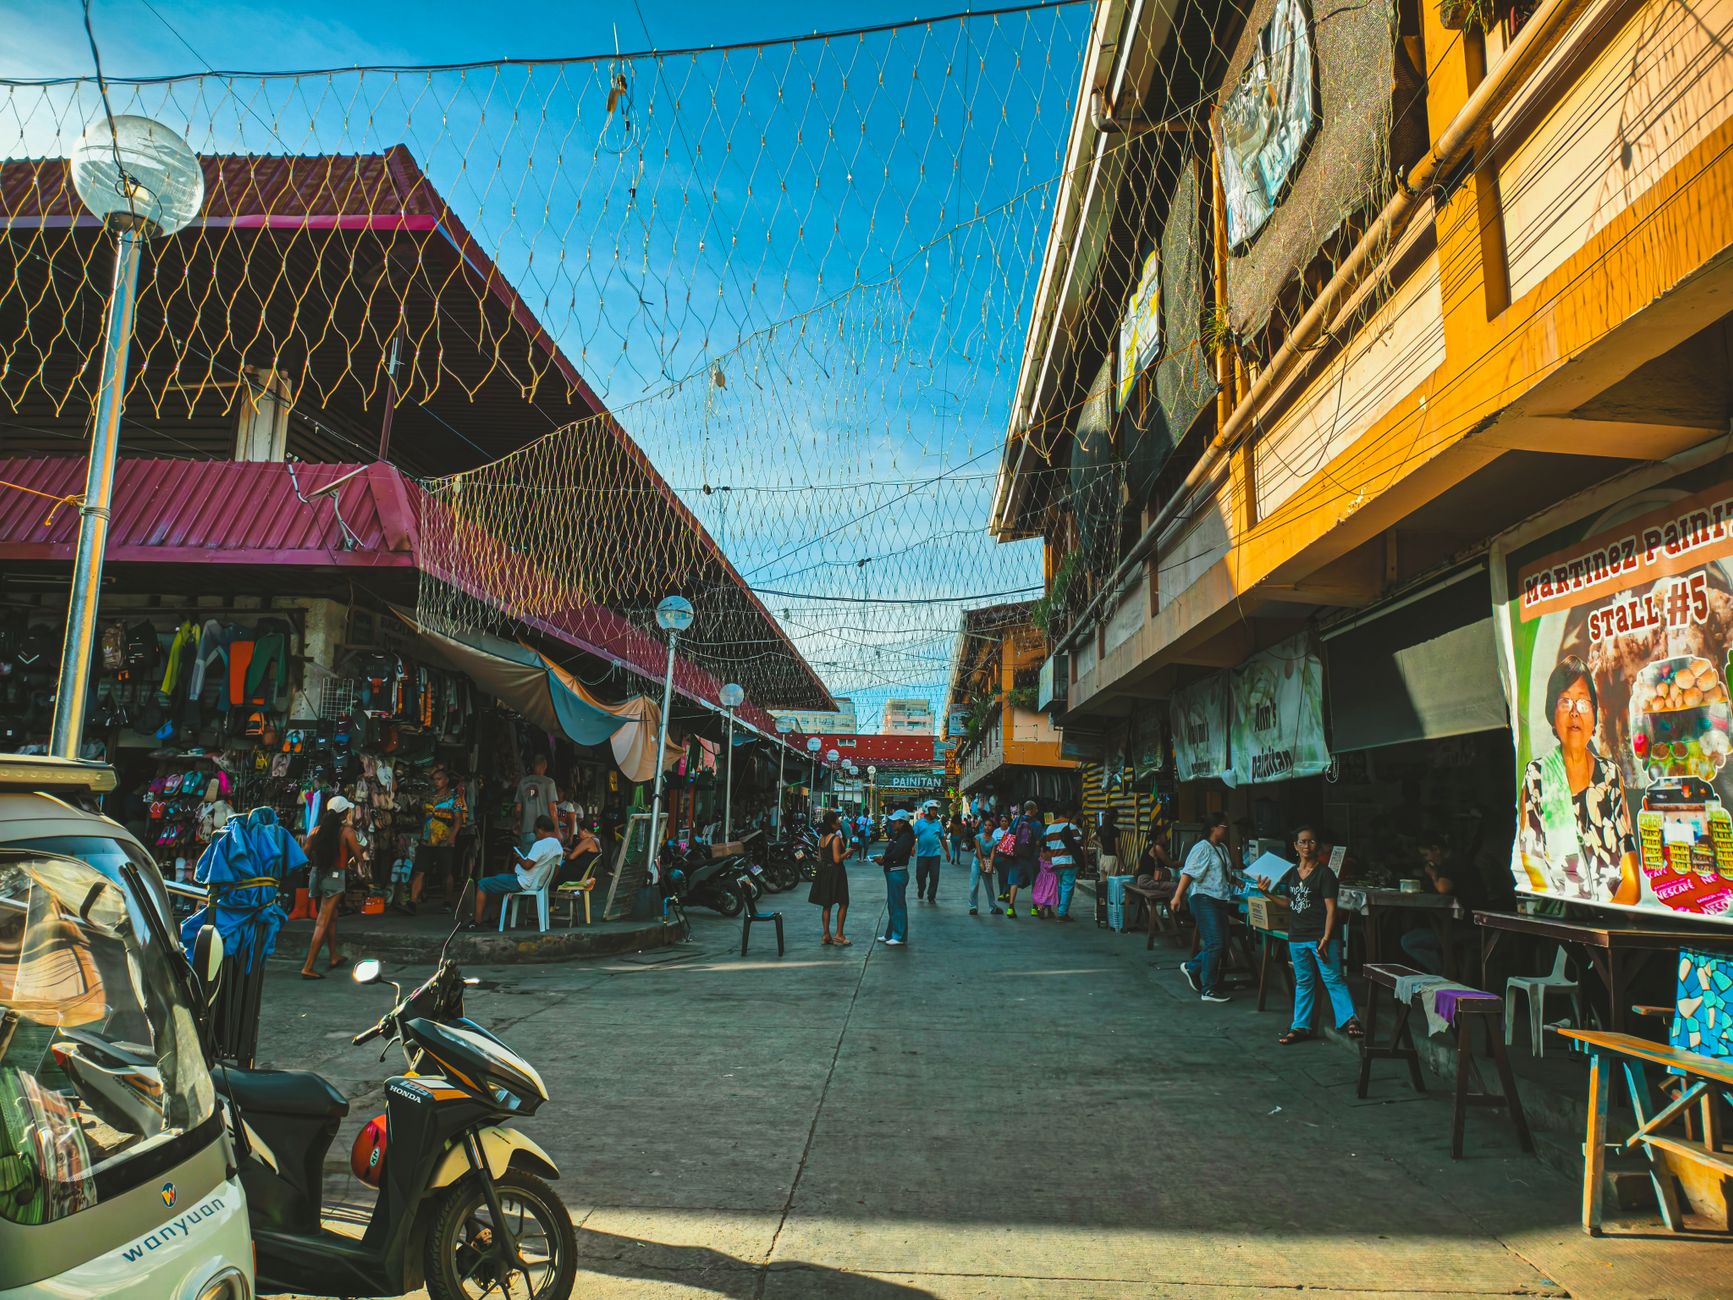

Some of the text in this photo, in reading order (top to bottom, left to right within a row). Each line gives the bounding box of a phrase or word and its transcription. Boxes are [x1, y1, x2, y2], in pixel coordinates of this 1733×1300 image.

[1667, 573, 1708, 627] #5
[893, 777, 941, 788] PAINITAN
[390, 1085, 422, 1104] HONDA
[122, 1198, 226, 1263] wanyuan
